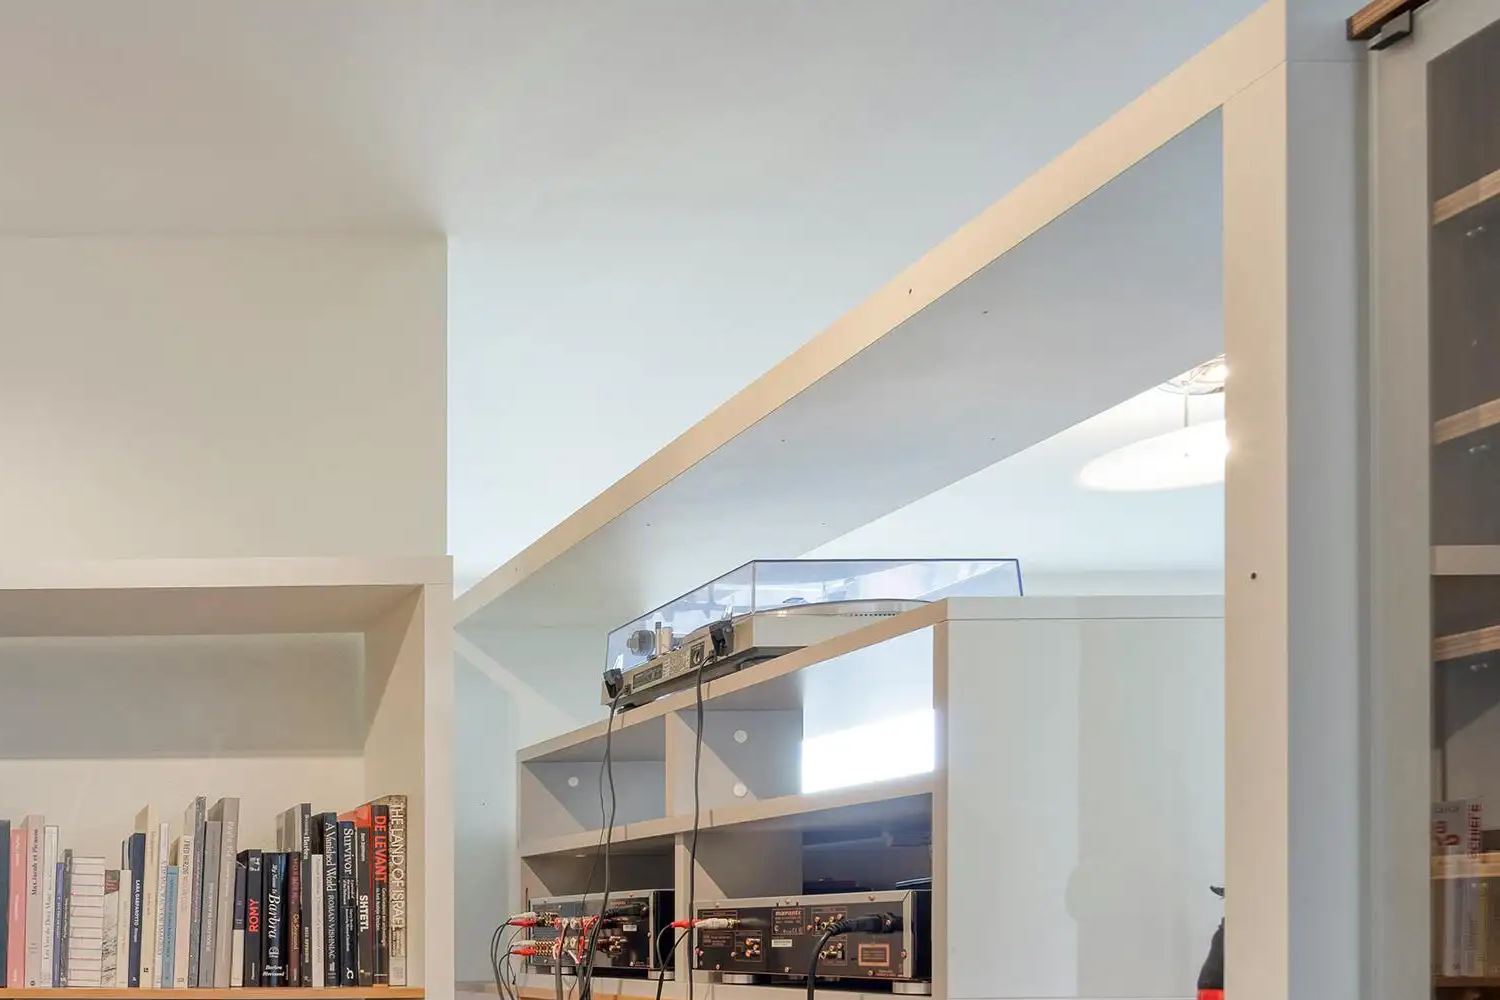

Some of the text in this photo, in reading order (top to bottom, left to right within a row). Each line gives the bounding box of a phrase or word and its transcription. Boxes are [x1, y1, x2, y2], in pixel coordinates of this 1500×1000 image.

[326, 822, 336, 831] A
[325, 833, 337, 866] Vanished
[343, 828, 354, 874] Survivor
[374, 815, 387, 883] DE LEVANT
[391, 803, 405, 930] THE LAND OF ISRAEL
[325, 868, 337, 892] World
[249, 898, 259, 932] ROMY
[359, 895, 369, 932] SHTETL
[328, 922, 336, 959] VISHNIAC
